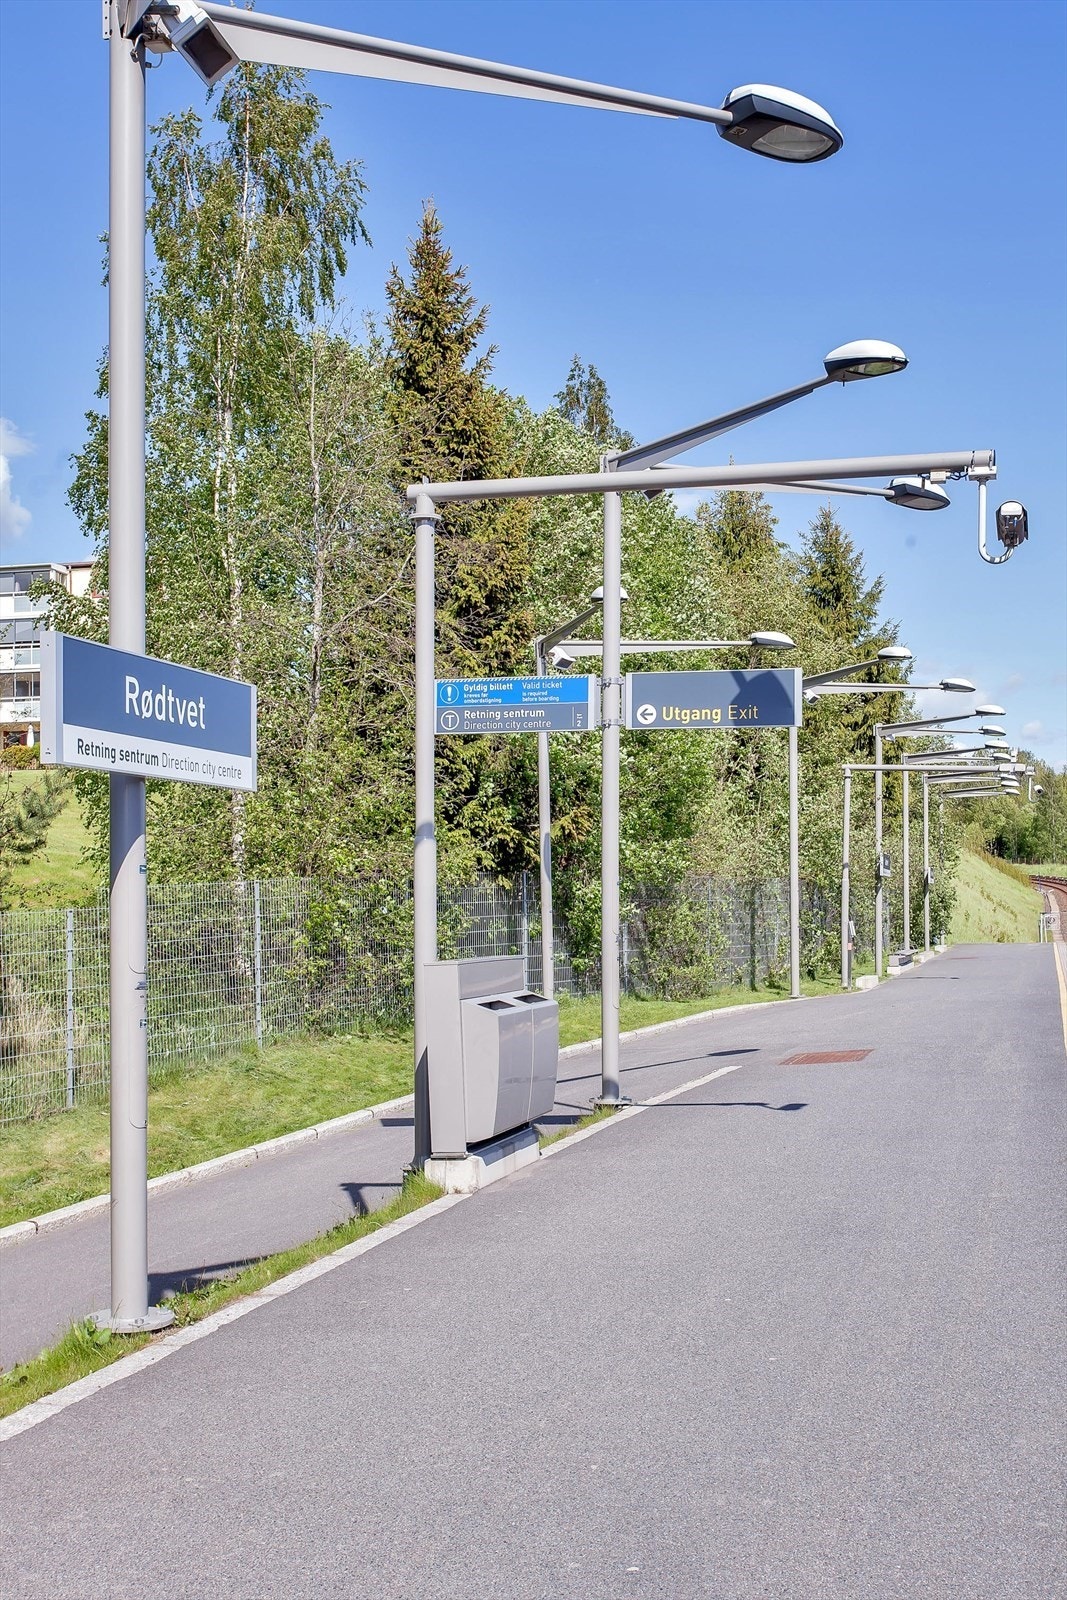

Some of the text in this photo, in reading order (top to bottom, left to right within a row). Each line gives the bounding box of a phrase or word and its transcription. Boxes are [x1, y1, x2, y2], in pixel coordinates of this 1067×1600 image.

[463, 683, 513, 693] Gyldig billett
[522, 681, 562, 690] Valid ticket
[125, 675, 206, 730] Rødtvet
[464, 710, 545, 720] Retning sentrum
[662, 704, 759, 724] Utgang Exit
[464, 720, 552, 731] Direction city centre
[77, 738, 242, 780] Retning sentrum Direction city centre
